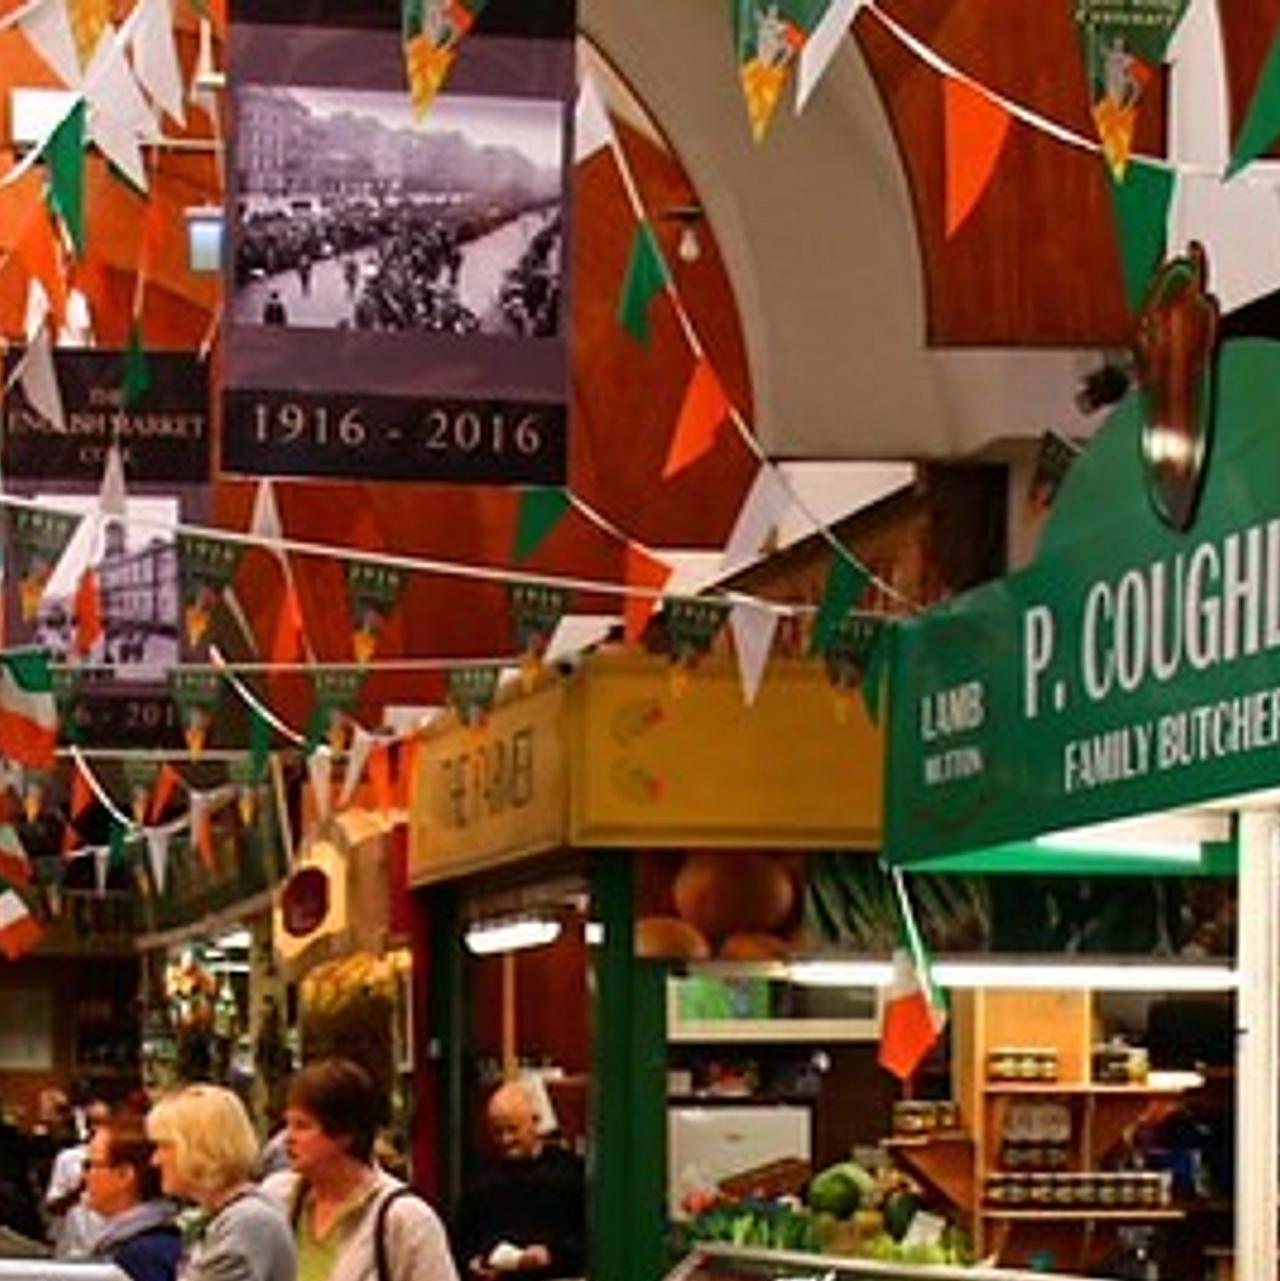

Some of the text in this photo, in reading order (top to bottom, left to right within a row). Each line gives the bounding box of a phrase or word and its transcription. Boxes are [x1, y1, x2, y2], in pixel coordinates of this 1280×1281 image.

[253, 403, 367, 448] 1916
[425, 408, 544, 455] 2016
[1024, 604, 1066, 719] P.
[920, 680, 986, 742] LAMB
[1064, 717, 1156, 793] FAMILY
